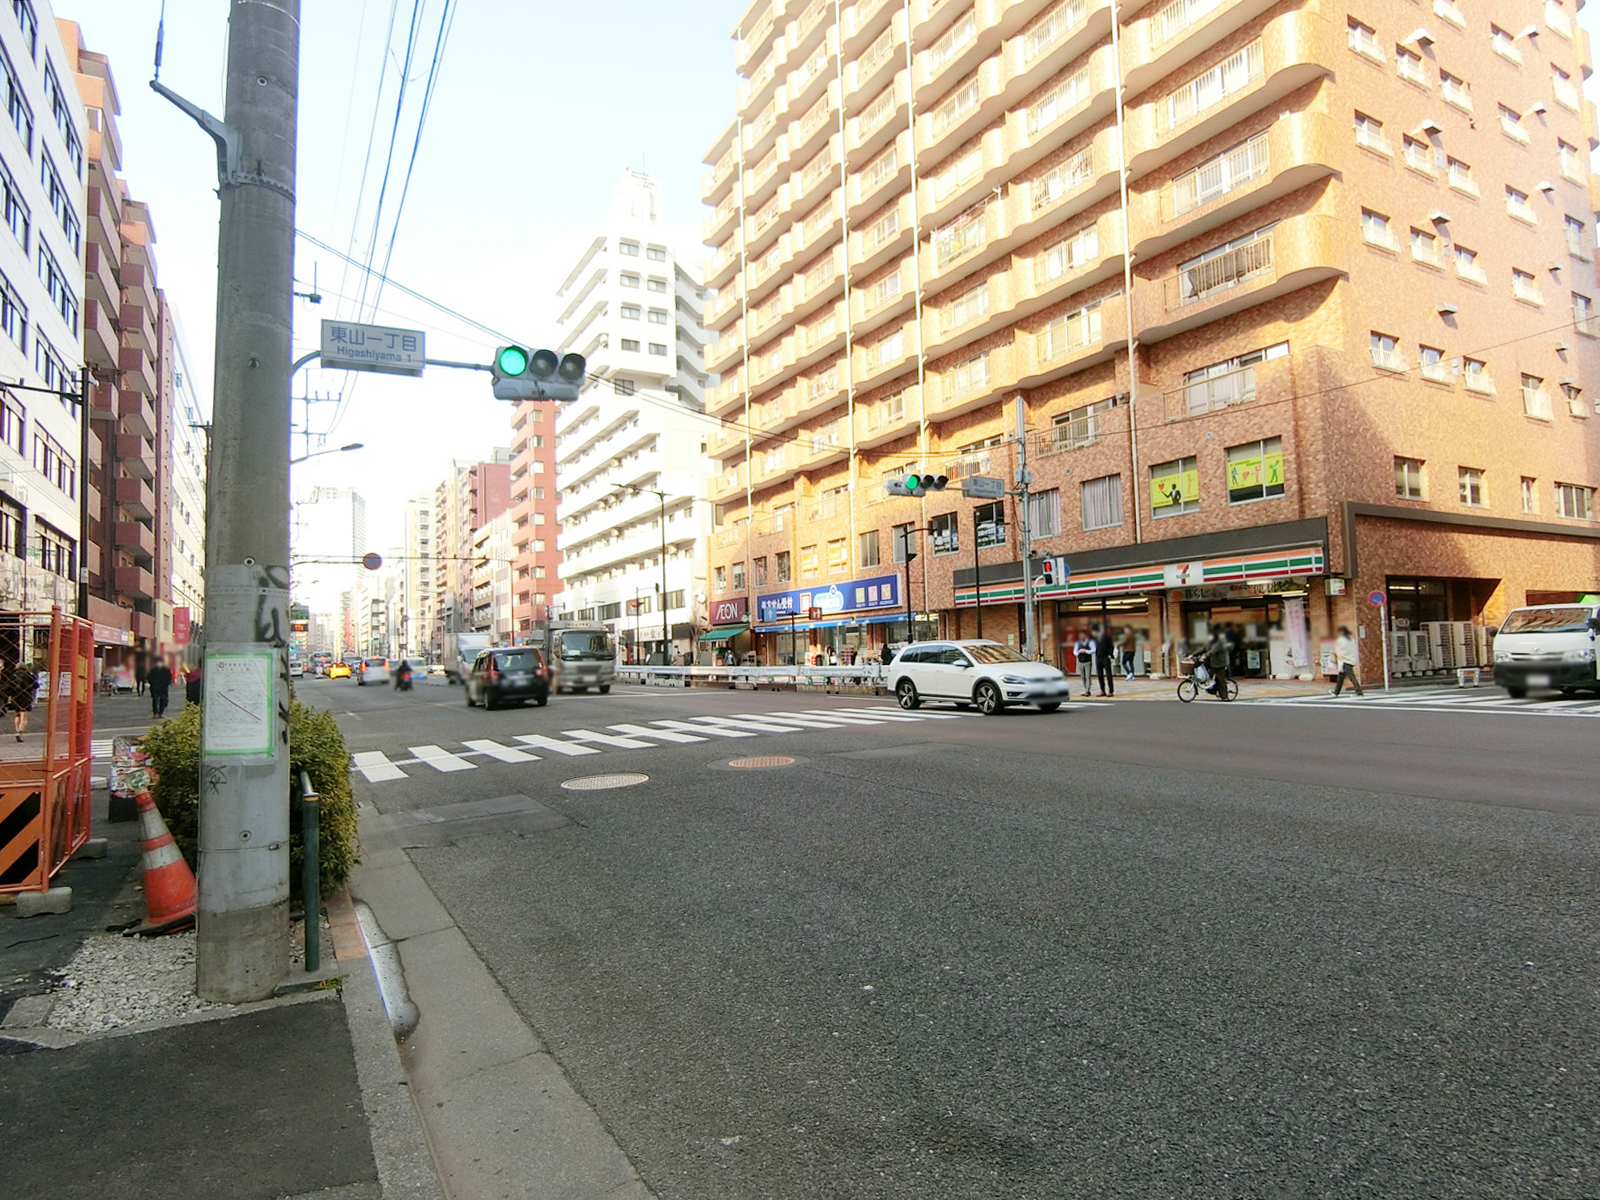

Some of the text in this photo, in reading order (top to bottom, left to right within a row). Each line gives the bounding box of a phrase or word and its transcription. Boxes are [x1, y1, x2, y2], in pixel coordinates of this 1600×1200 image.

[330, 326, 417, 352] 東山一丁目
[337, 346, 413, 363] Higashiyama 1
[716, 603, 738, 620] AEON
